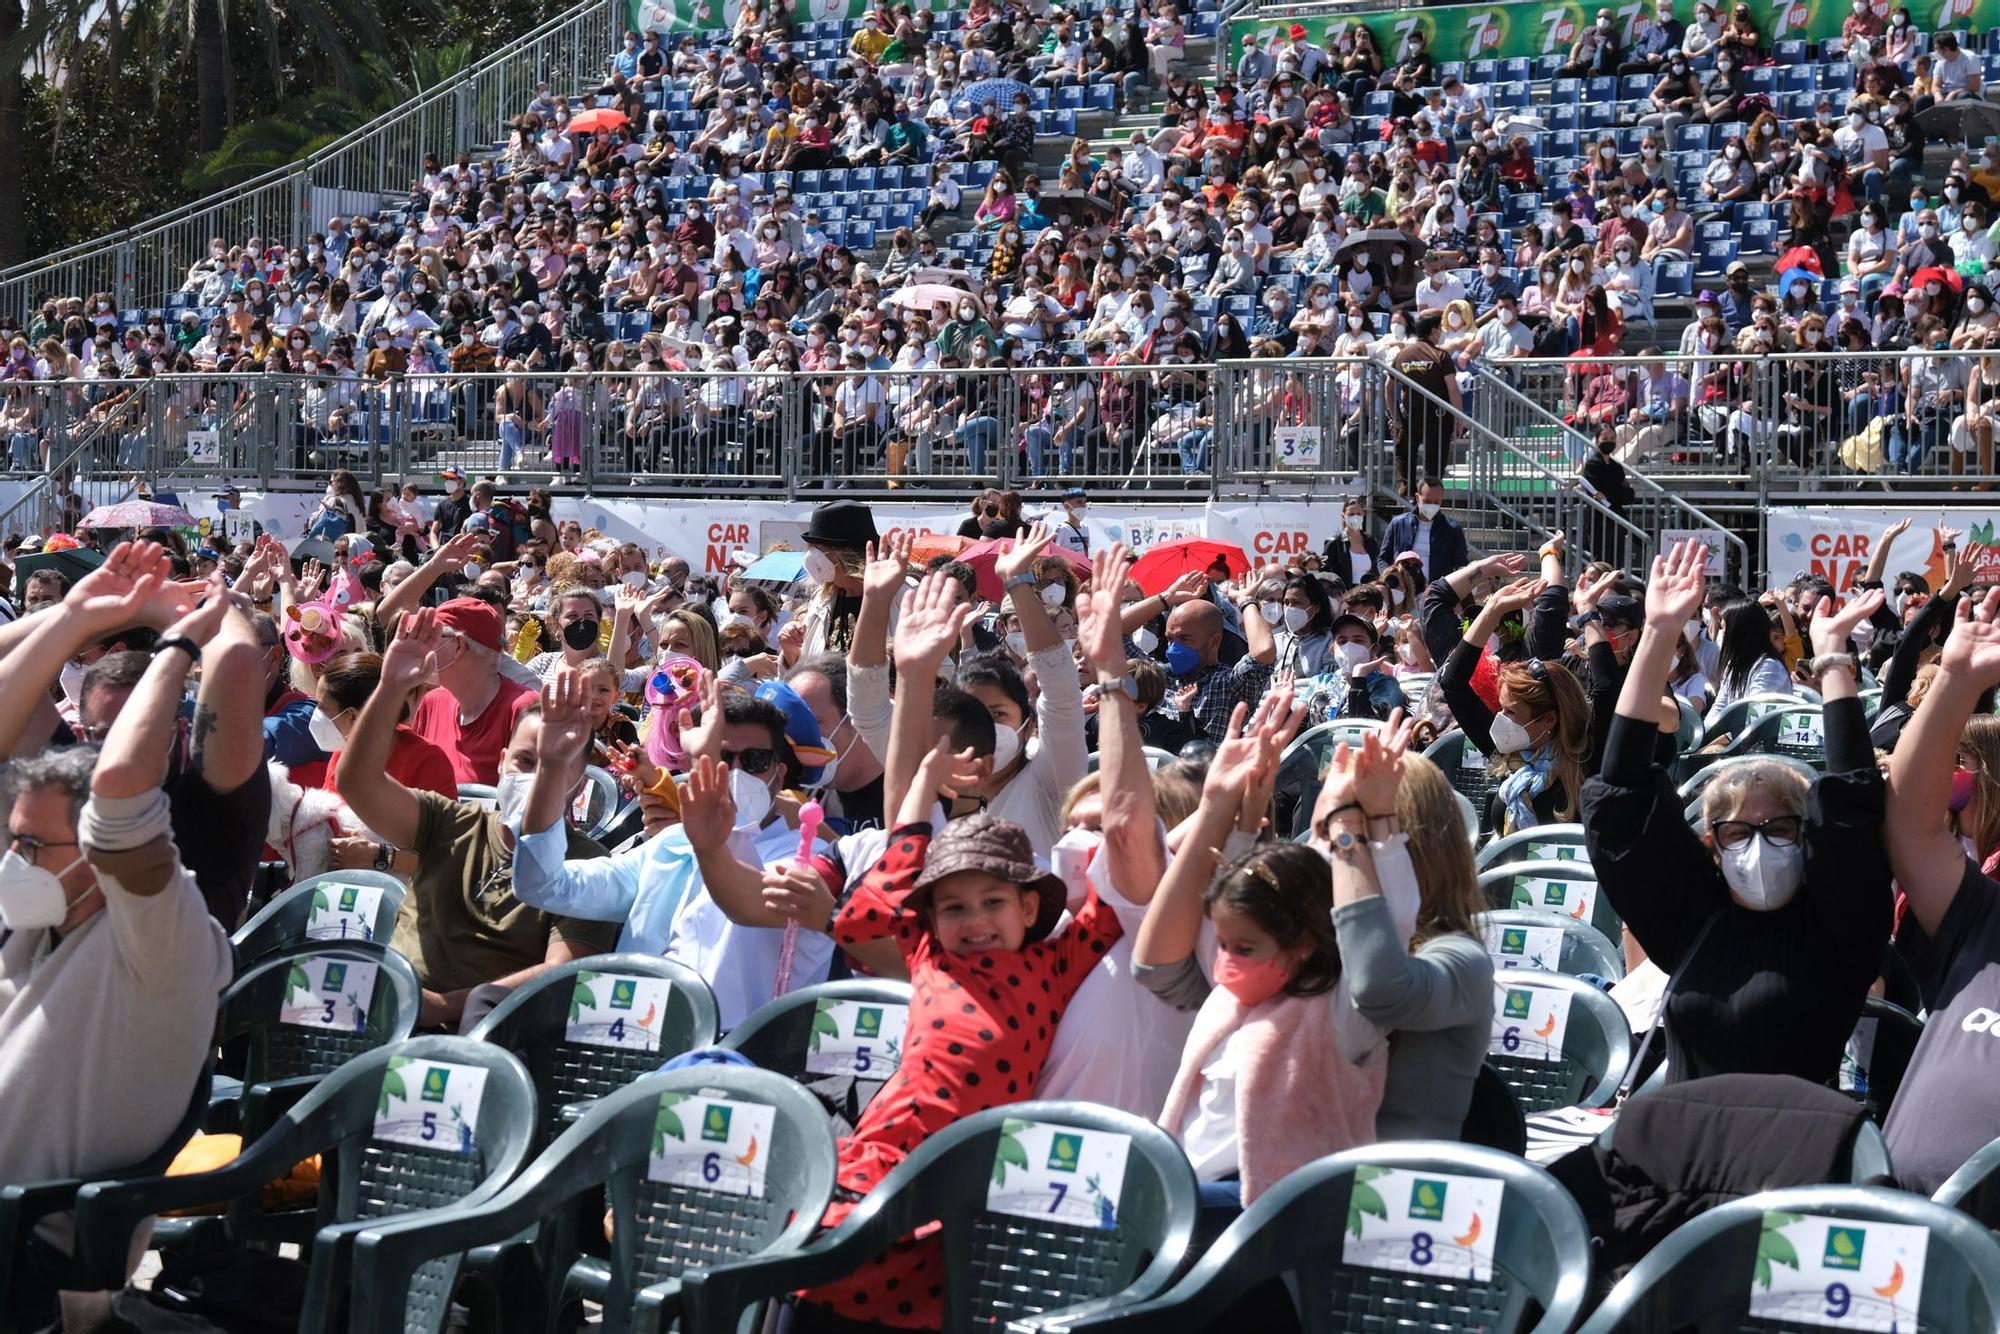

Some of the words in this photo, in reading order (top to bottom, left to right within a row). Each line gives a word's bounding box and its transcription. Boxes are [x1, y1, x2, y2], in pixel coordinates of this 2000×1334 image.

[192, 441, 201, 455] 2
[1283, 438, 1295, 456] 3
[708, 524, 749, 543] CAR
[1131, 529, 1142, 546] B
[1254, 531, 1309, 554] CAR
[1811, 534, 1869, 557] CAR
[1796, 732, 1809, 743] 14
[340, 918, 347, 939] 1
[321, 999, 336, 1023] 3
[608, 1017, 625, 1042] 4
[1503, 1026, 1520, 1051] 6
[854, 1046, 871, 1072] 5
[421, 1111, 437, 1140] 5
[703, 1152, 720, 1183] 6
[1047, 1182, 1068, 1213] 7
[1410, 1231, 1433, 1265] 8
[1824, 1282, 1851, 1318] 9
